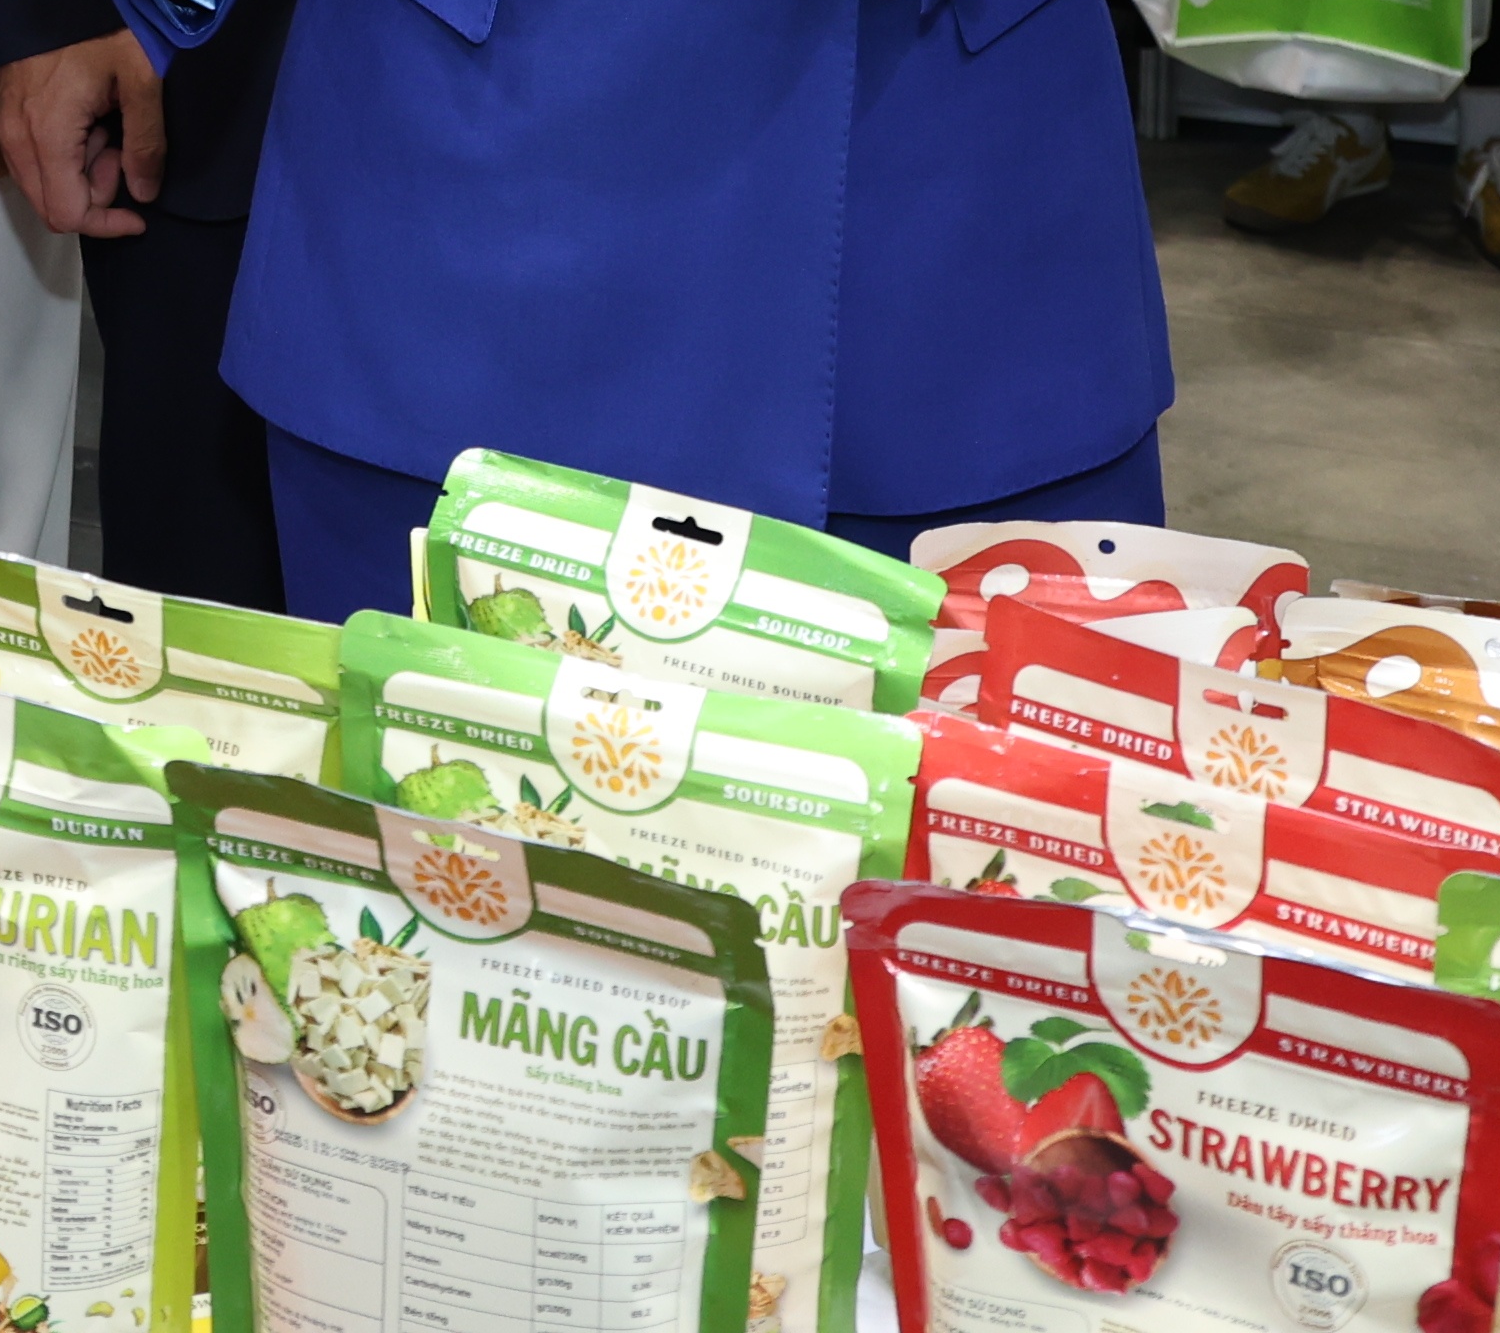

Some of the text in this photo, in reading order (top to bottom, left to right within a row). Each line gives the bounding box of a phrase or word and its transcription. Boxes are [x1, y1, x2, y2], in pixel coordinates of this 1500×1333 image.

[450, 531, 592, 582] FREEZE DRIED
[757, 615, 851, 651] SOURSOP
[216, 687, 300, 711] DURIAN
[663, 655, 844, 707] FREEZE DRIED SOURSOP
[374, 705, 535, 753] FREEZE DRIED
[1010, 697, 1172, 762] FREEZE DRIED
[722, 784, 832, 818] SOURSOP
[52, 817, 144, 841] DURIAN
[927, 812, 1105, 867] FREEZE DRIED
[629, 827, 690, 851] FREEZE
[695, 842, 746, 865] DRIED
[750, 854, 825, 884] SOURSOP
[31, 871, 88, 893] DRIED
[1276, 903, 1435, 963] STRAWBERR
[133, 974, 164, 989] hoa
[480, 956, 692, 1011] FREEZE DRIED SOURSOP
[1007, 969, 1091, 1004] DRIED
[32, 1006, 82, 1035] ISO
[460, 988, 709, 1082] MÃNG CẦU
[1278, 1037, 1469, 1099] STRAWBERRY
[66, 1098, 142, 1113] Nutrition Facts
[1197, 1089, 1357, 1142] FREEZE DRIED
[1148, 1107, 1450, 1215] STRAWBERRY
[1400, 1224, 1437, 1246] hoa
[1288, 1263, 1350, 1298] ISO
